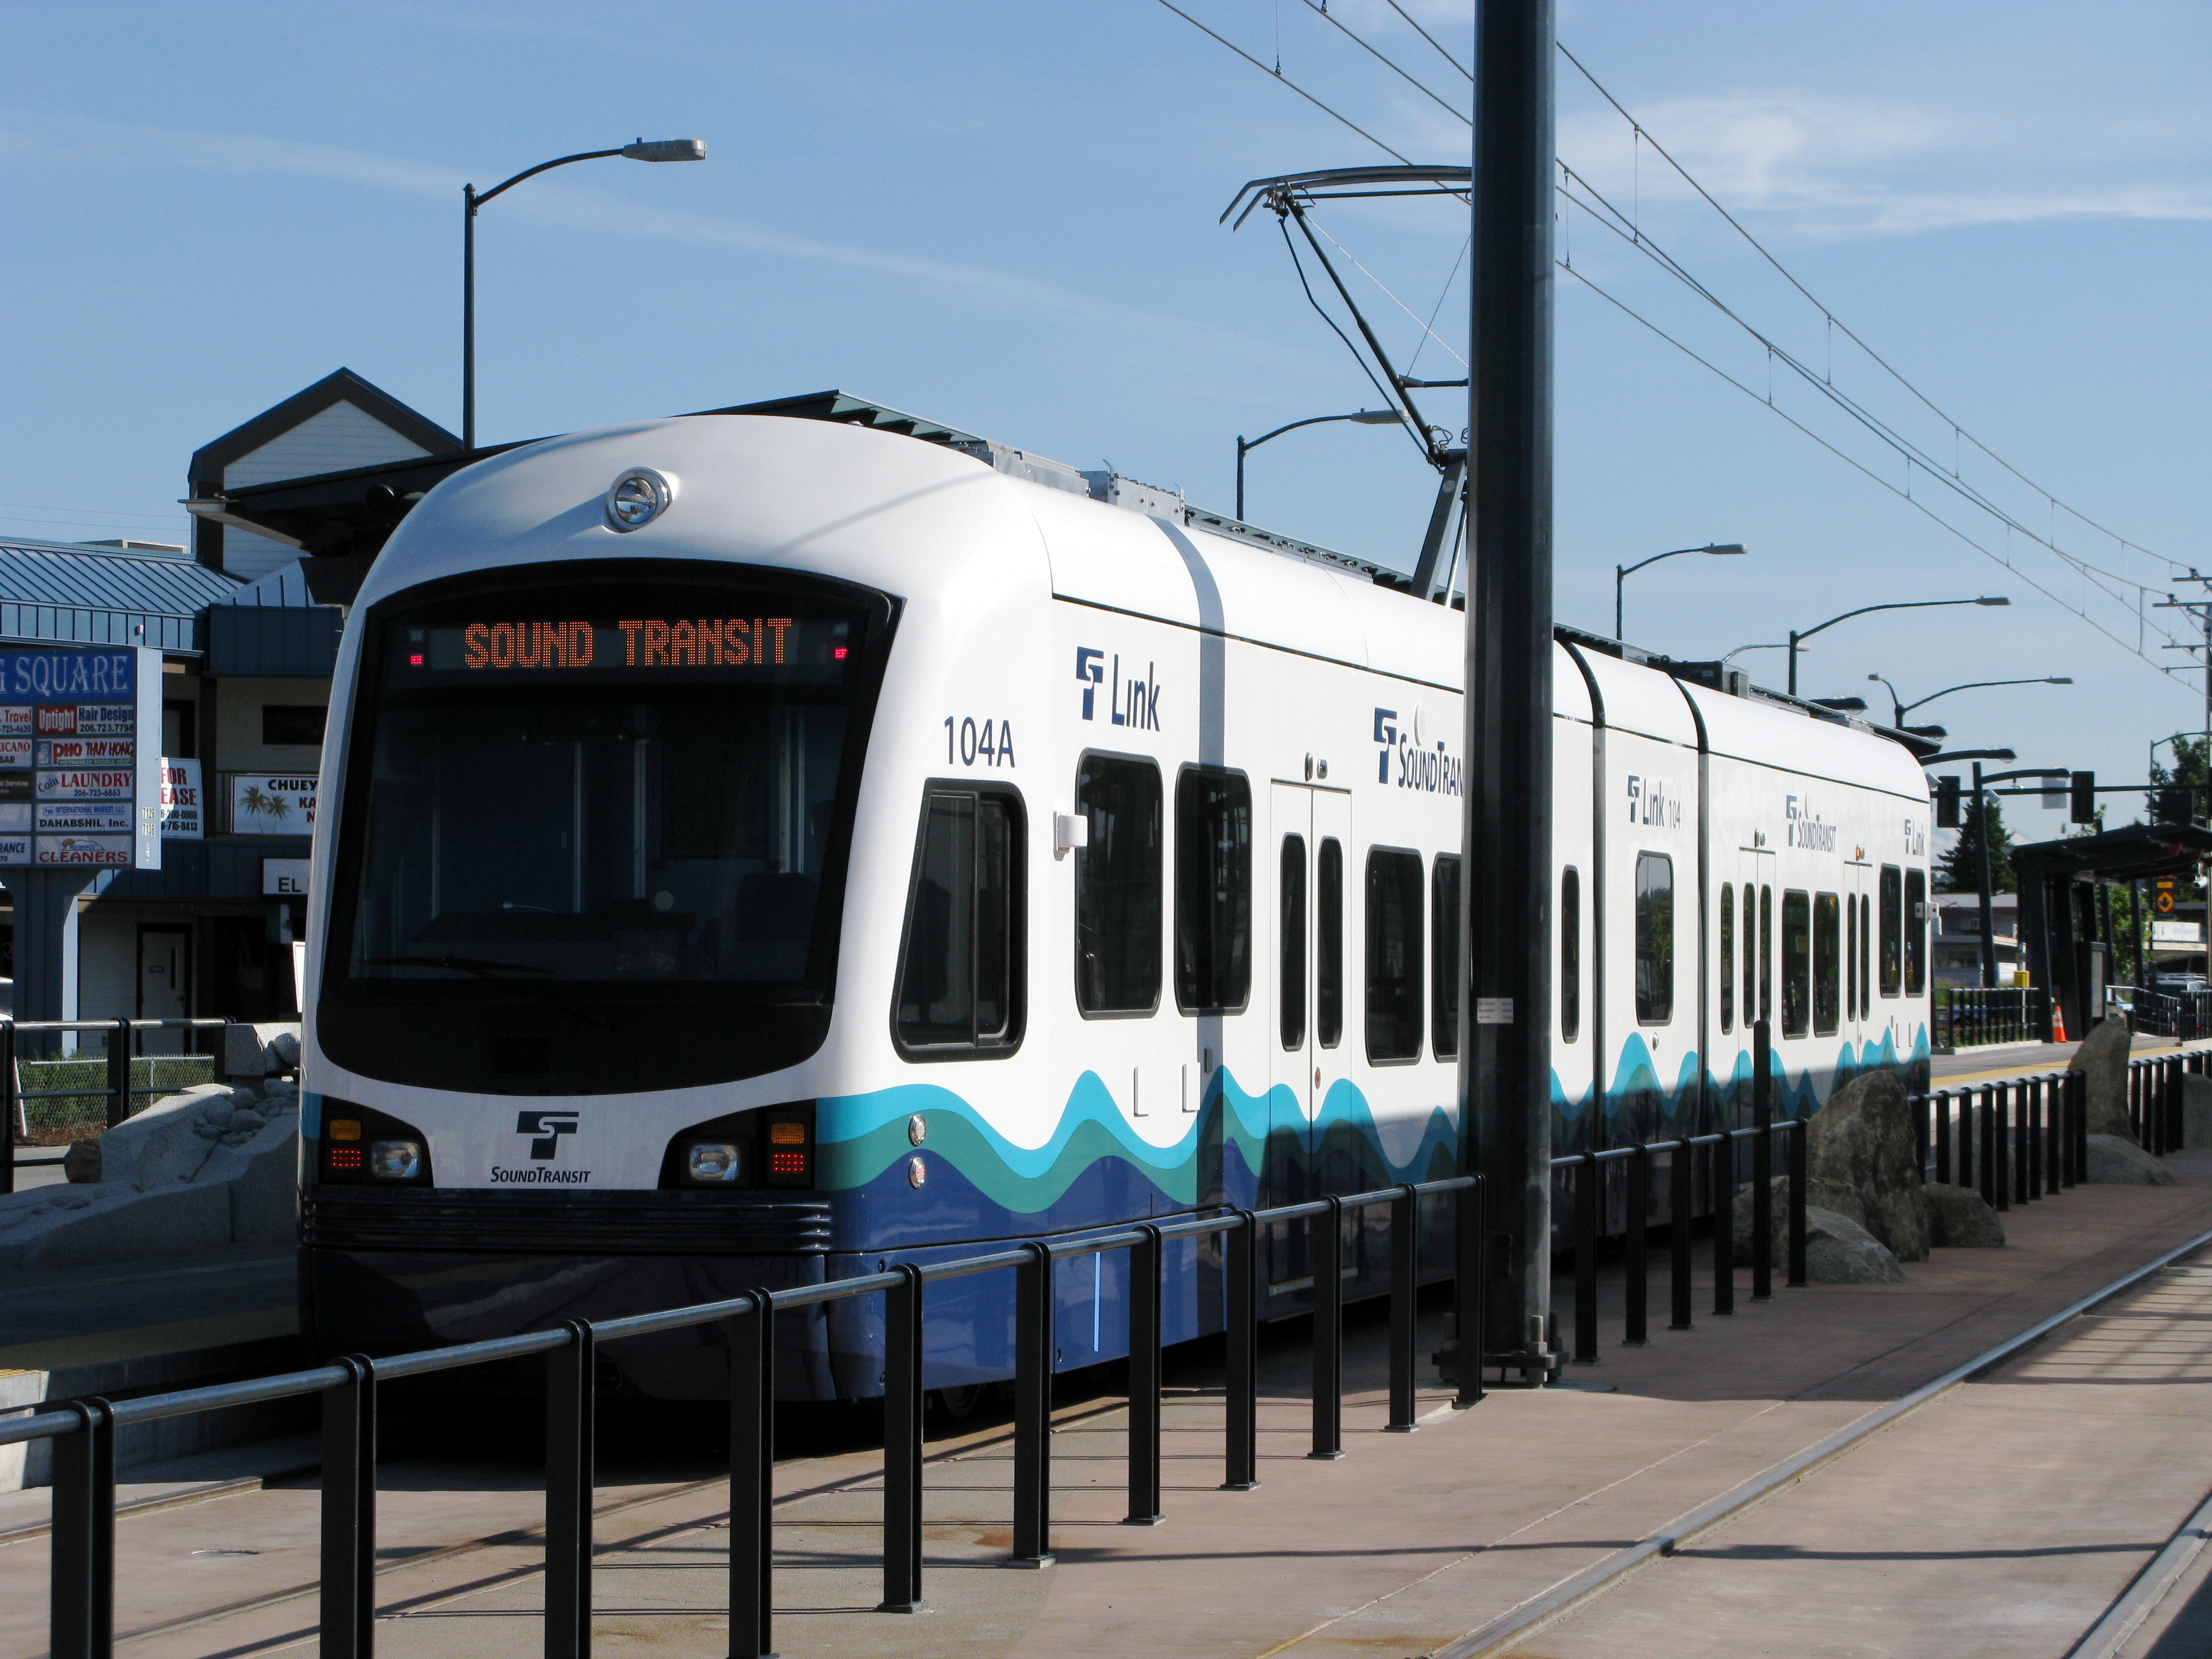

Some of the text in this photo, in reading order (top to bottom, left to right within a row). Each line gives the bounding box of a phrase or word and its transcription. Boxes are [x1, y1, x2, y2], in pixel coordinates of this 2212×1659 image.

[463, 617, 793, 668] SOUND TRANSIT
[15, 656, 129, 697] SQUARE
[1111, 654, 1161, 732] Link
[4, 708, 32, 723] Travel
[39, 707, 133, 732] Uptight Hair Design
[80, 723, 133, 733] 206.723.7798
[0, 742, 30, 752] ICANO
[944, 716, 1015, 768] 104A
[53, 742, 82, 765] PHO
[108, 741, 133, 758] HONG
[1398, 732, 1463, 797] SOUNDTRAN
[38, 773, 133, 792] Coin LAUNDRY
[161, 766, 187, 786] FOR
[74, 789, 121, 797] 206-723-6863
[161, 787, 197, 806] EASE
[1642, 777, 1665, 827] Link
[1668, 799, 1681, 830] 104
[109, 818, 128, 827] Inc.
[142, 807, 155, 820] 7126
[161, 809, 197, 820] 6-200-0966
[161, 821, 197, 832] 6-715-9413
[39, 851, 128, 863] CLEANERS
[278, 877, 302, 893] EL
